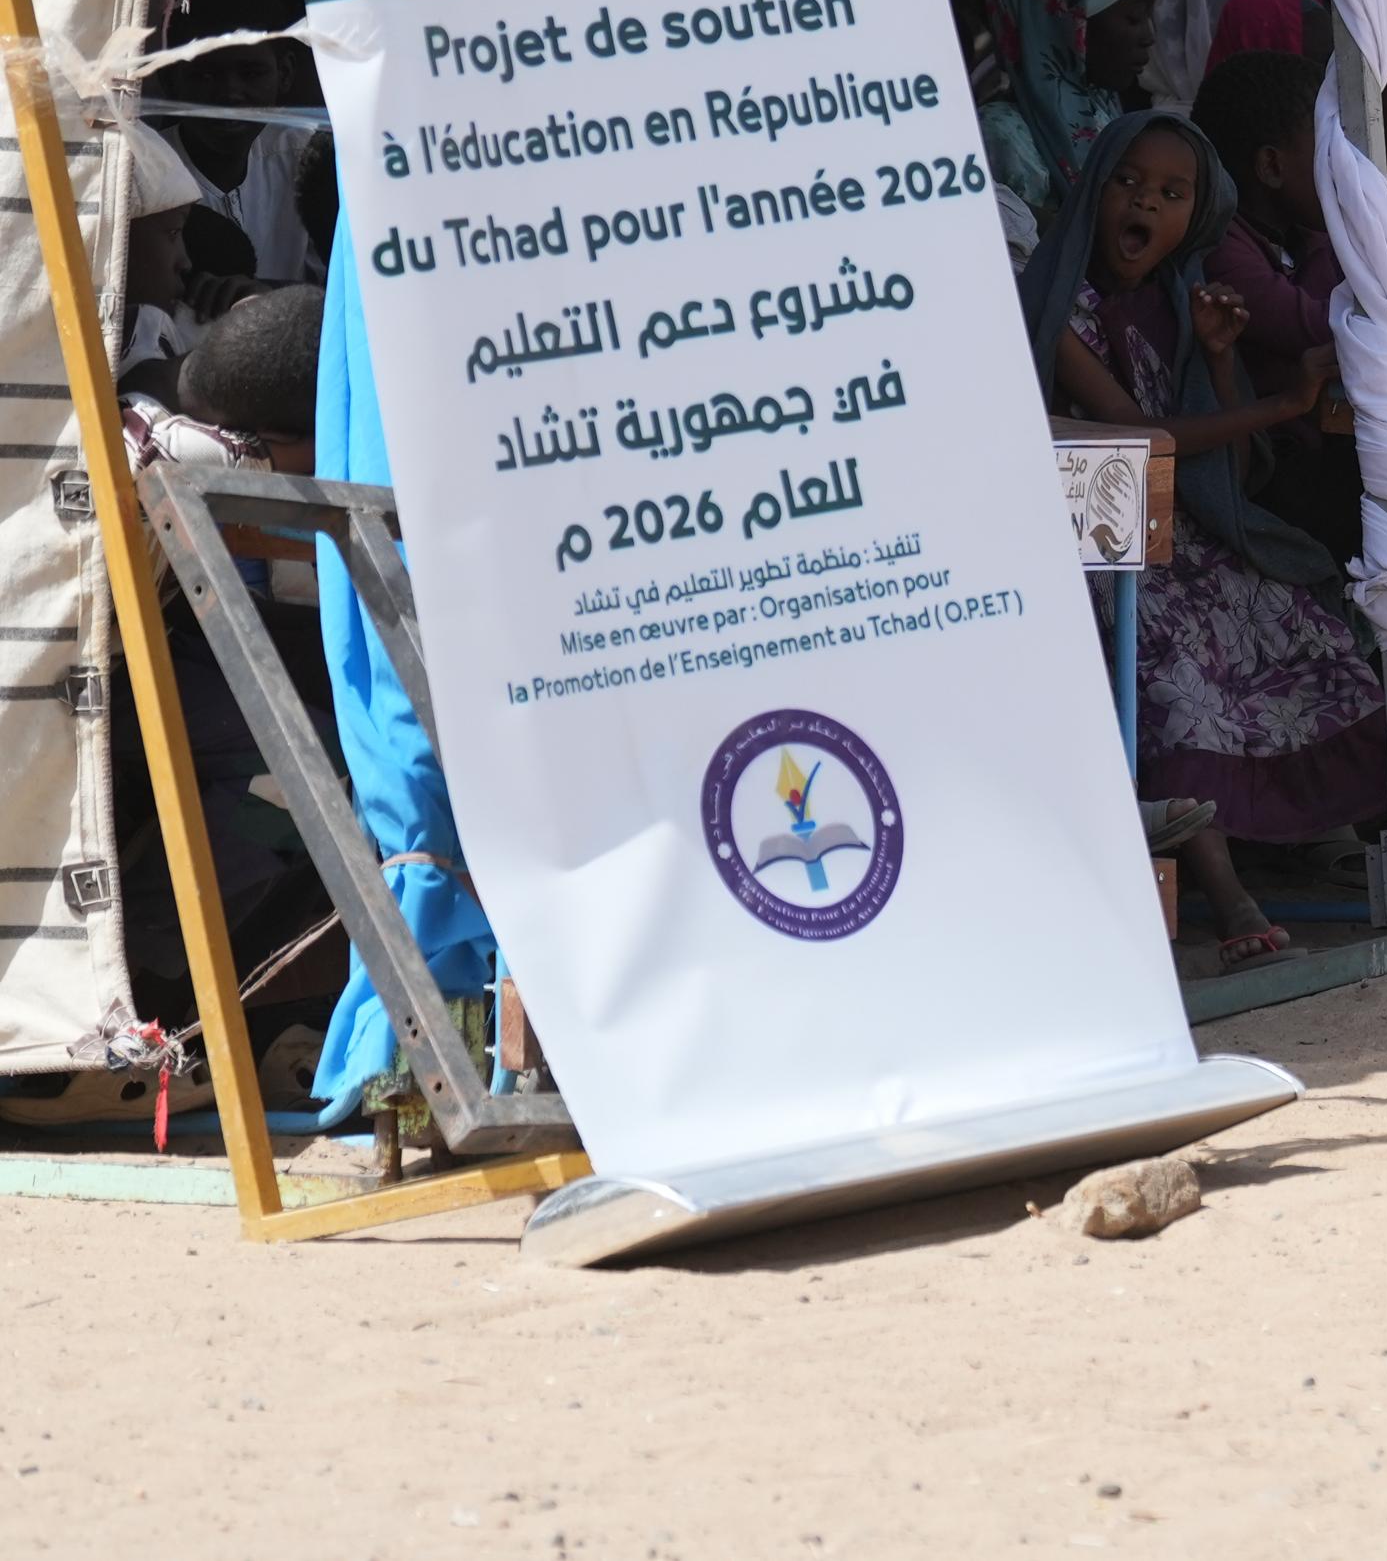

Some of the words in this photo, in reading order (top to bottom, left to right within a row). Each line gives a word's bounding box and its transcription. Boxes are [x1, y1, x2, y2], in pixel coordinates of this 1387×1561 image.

[424, 15, 573, 82] Projet
[585, 7, 648, 58] de
[381, 131, 410, 179] à
[419, 110, 634, 175] l'éducation
[644, 106, 697, 145] en
[705, 71, 940, 142] République
[371, 227, 436, 278] du
[443, 206, 569, 269] Tchad
[582, 199, 686, 263] pour
[697, 168, 866, 234] l'année
[875, 153, 987, 206] 2026
[638, 295, 735, 358] دعم
[749, 256, 915, 339] مشروع
[466, 299, 620, 383] التعليم
[615, 385, 814, 459] جمهورية
[832, 359, 906, 424] في
[496, 405, 601, 472] تشاد
[603, 490, 724, 551] 2026
[742, 456, 863, 540] للعام
[555, 523, 593, 572] م
[738, 556, 791, 592] تطوير
[797, 546, 861, 575] منظمة
[560, 629, 606, 655] Mise
[610, 626, 636, 647] en
[639, 614, 709, 641] œuvre
[760, 578, 899, 619] Organisation
[903, 568, 951, 598] pour
[574, 586, 620, 616] تشاد
[626, 580, 660, 615] في
[665, 566, 734, 603] التعليم
[507, 681, 529, 706] la
[531, 666, 637, 701] Promotion
[639, 658, 666, 681] de
[668, 626, 837, 676] l'Enseignement
[839, 624, 866, 644] au
[867, 606, 931, 638] Tchad
